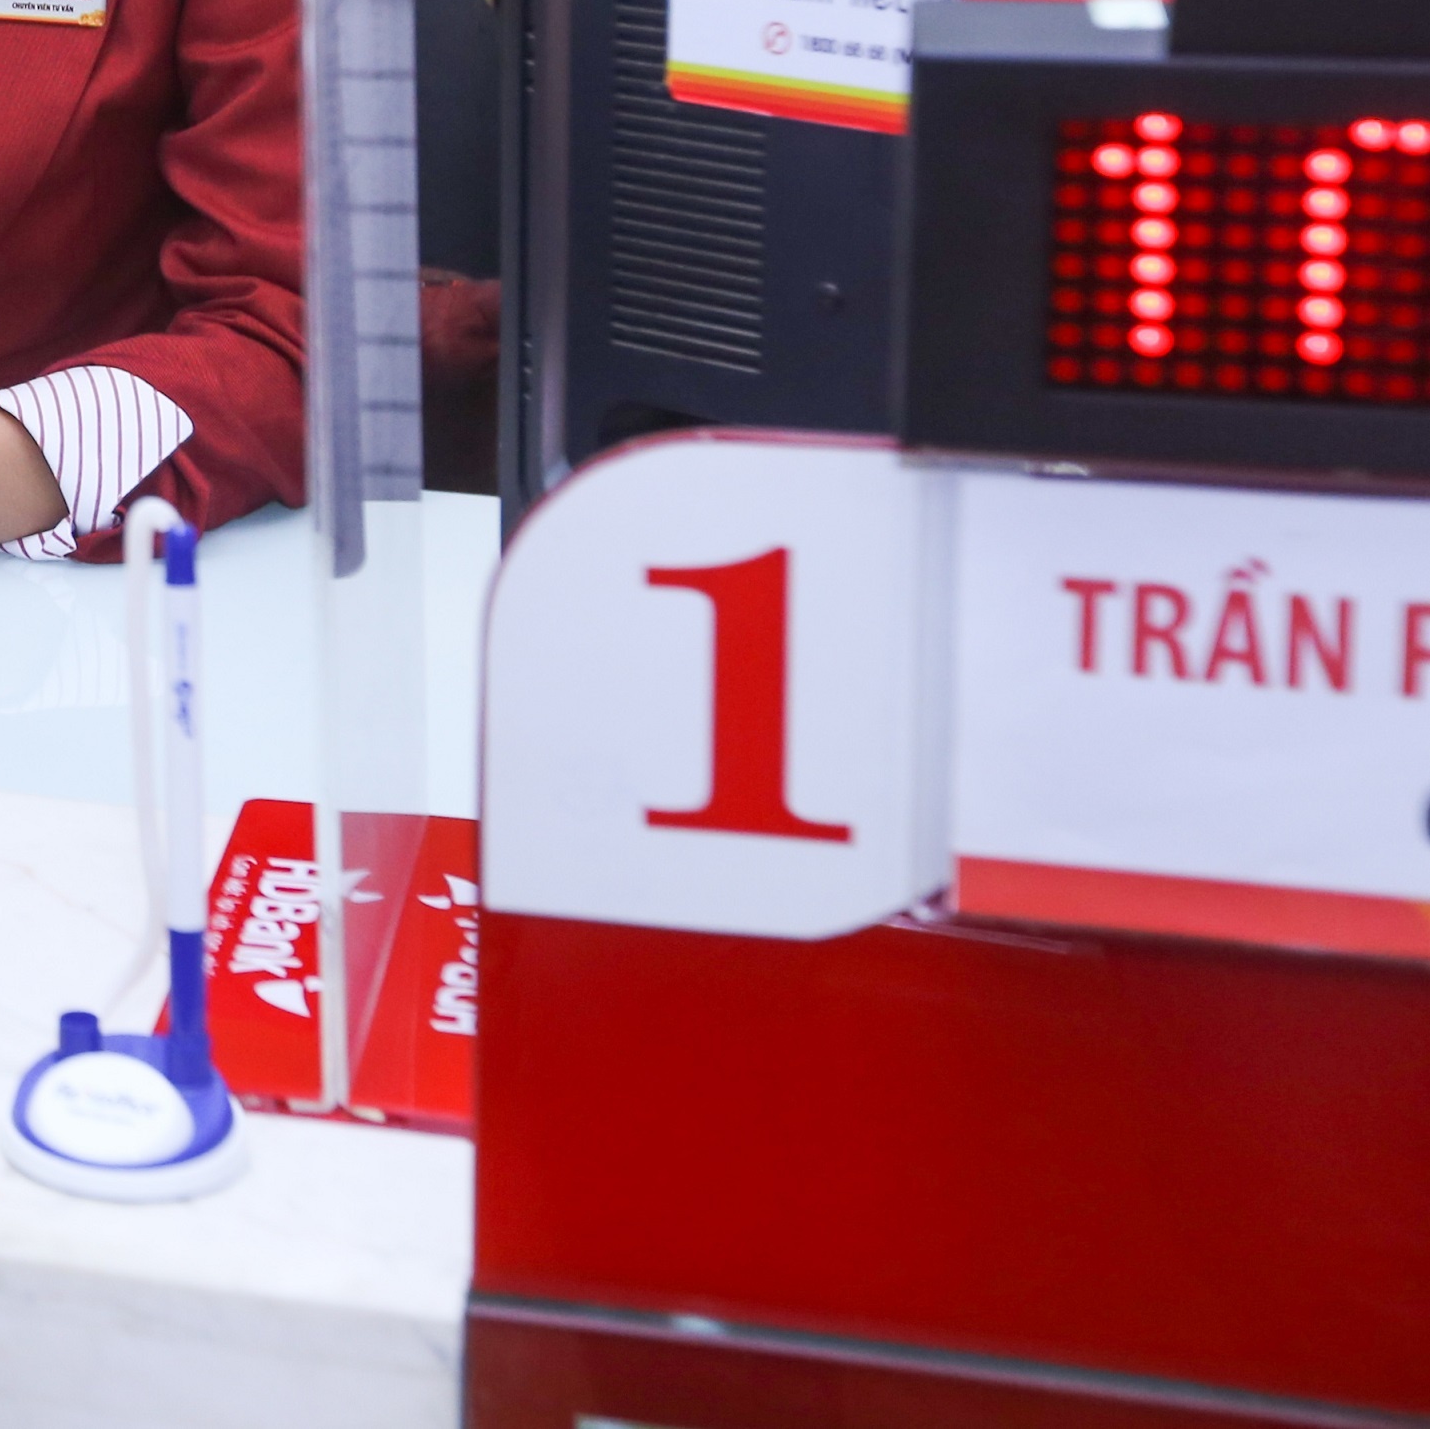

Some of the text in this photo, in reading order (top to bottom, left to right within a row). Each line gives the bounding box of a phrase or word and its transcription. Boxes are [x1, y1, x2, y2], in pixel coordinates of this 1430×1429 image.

[1063, 557, 1352, 693] TRẦN
[644, 546, 852, 843] 1
[228, 856, 320, 979] HDBank
